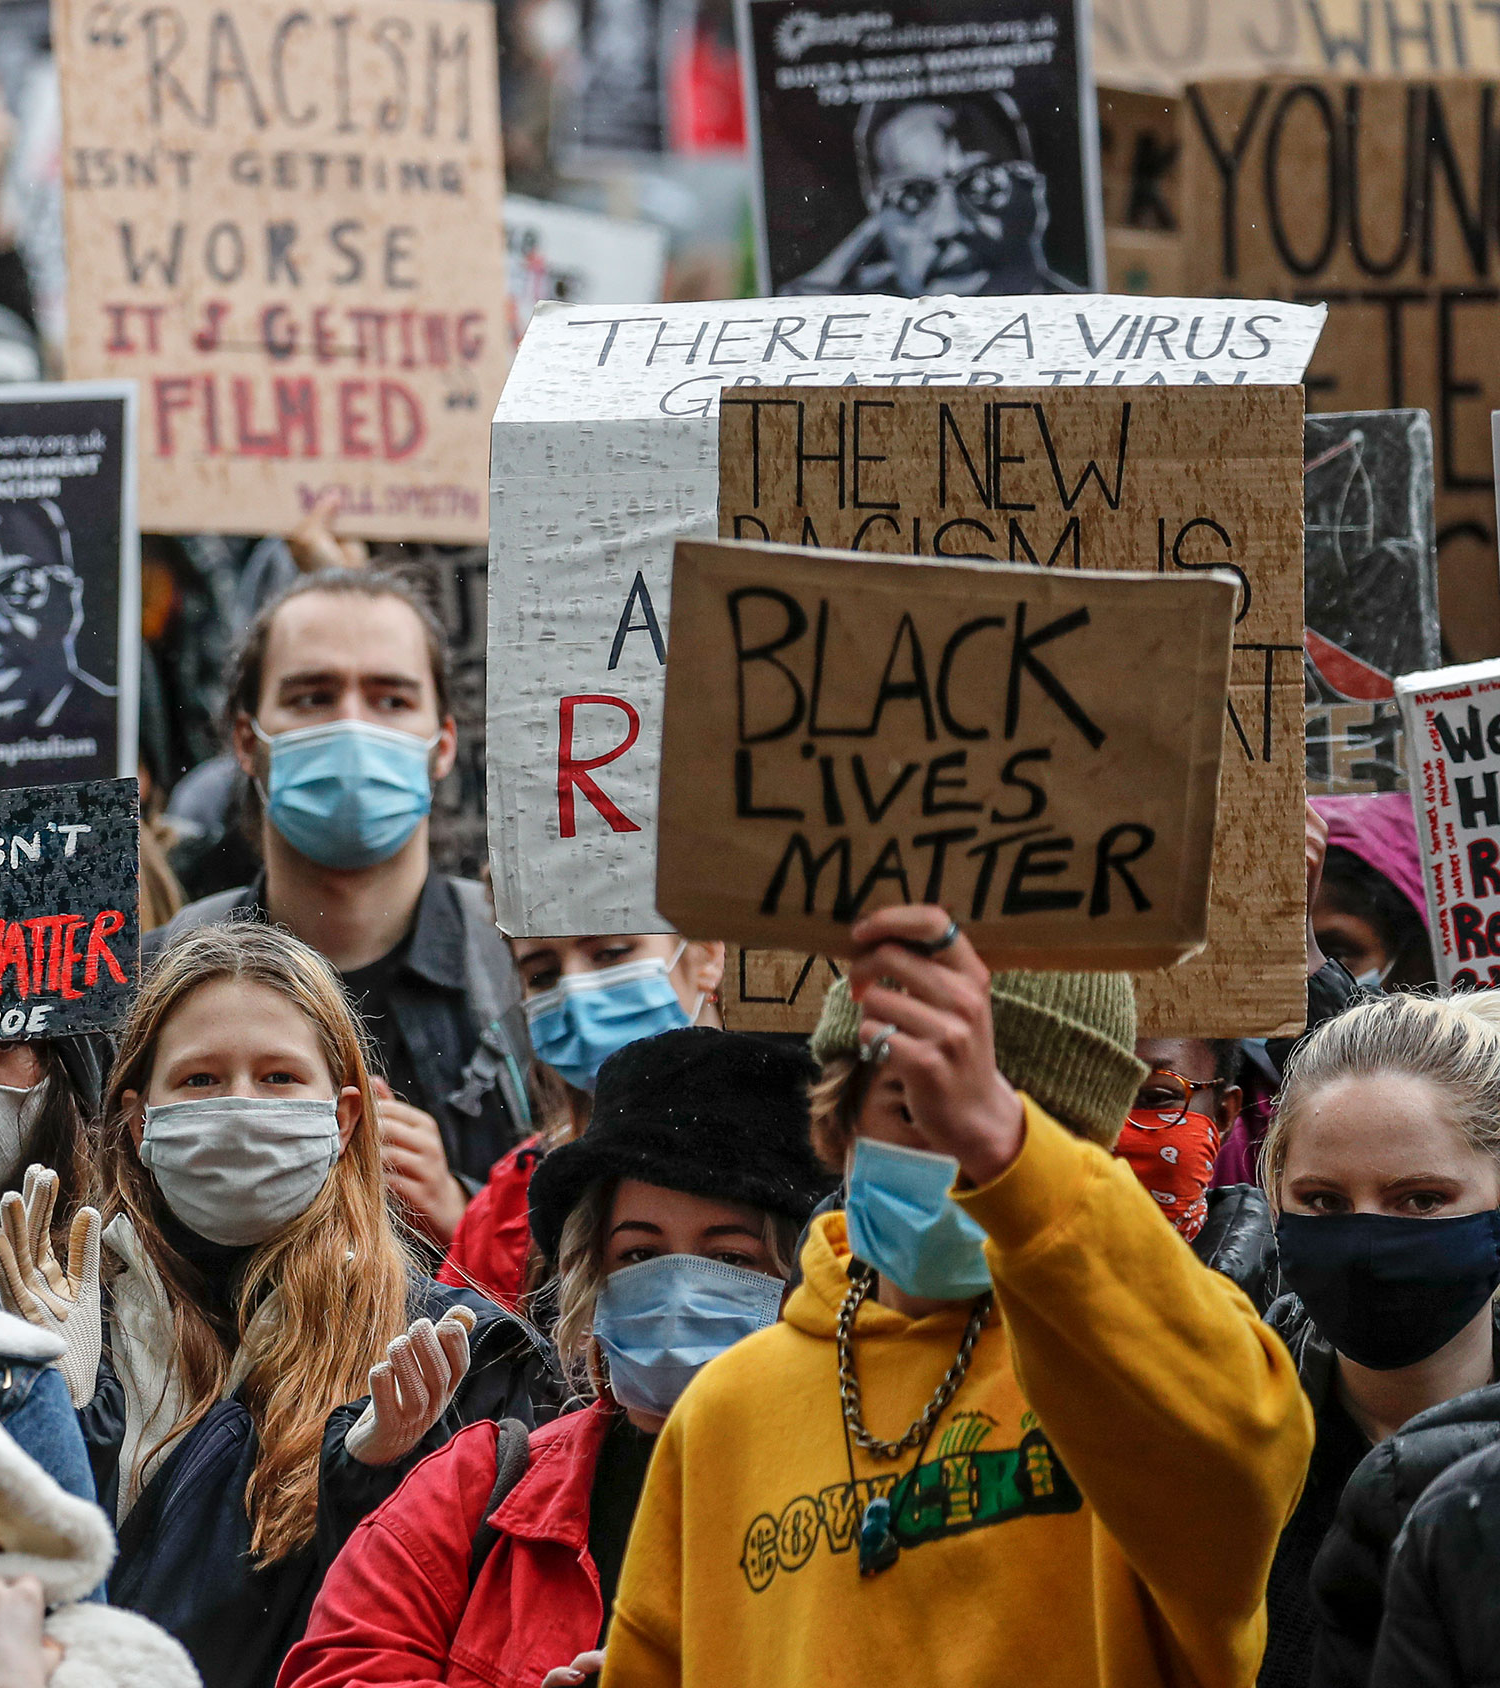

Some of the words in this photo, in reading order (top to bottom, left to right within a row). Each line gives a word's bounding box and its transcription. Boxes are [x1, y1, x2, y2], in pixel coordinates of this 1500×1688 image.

[925, 41, 1054, 71] MOVEMENT
[73, 142, 194, 192] ISN'T
[229, 149, 465, 194] GETTING
[1185, 82, 1500, 279] YOUN
[118, 217, 417, 290] WORSE
[261, 304, 486, 370] GETTING
[568, 313, 872, 367] THERE
[892, 310, 957, 362] IS
[972, 313, 1035, 362] A
[1075, 312, 1284, 363] VIRUS
[720, 399, 900, 510] THE
[939, 402, 1132, 511] NEW
[726, 585, 1106, 751] BLACK
[734, 743, 1051, 827] LIVES
[759, 822, 1155, 921] MATTER
